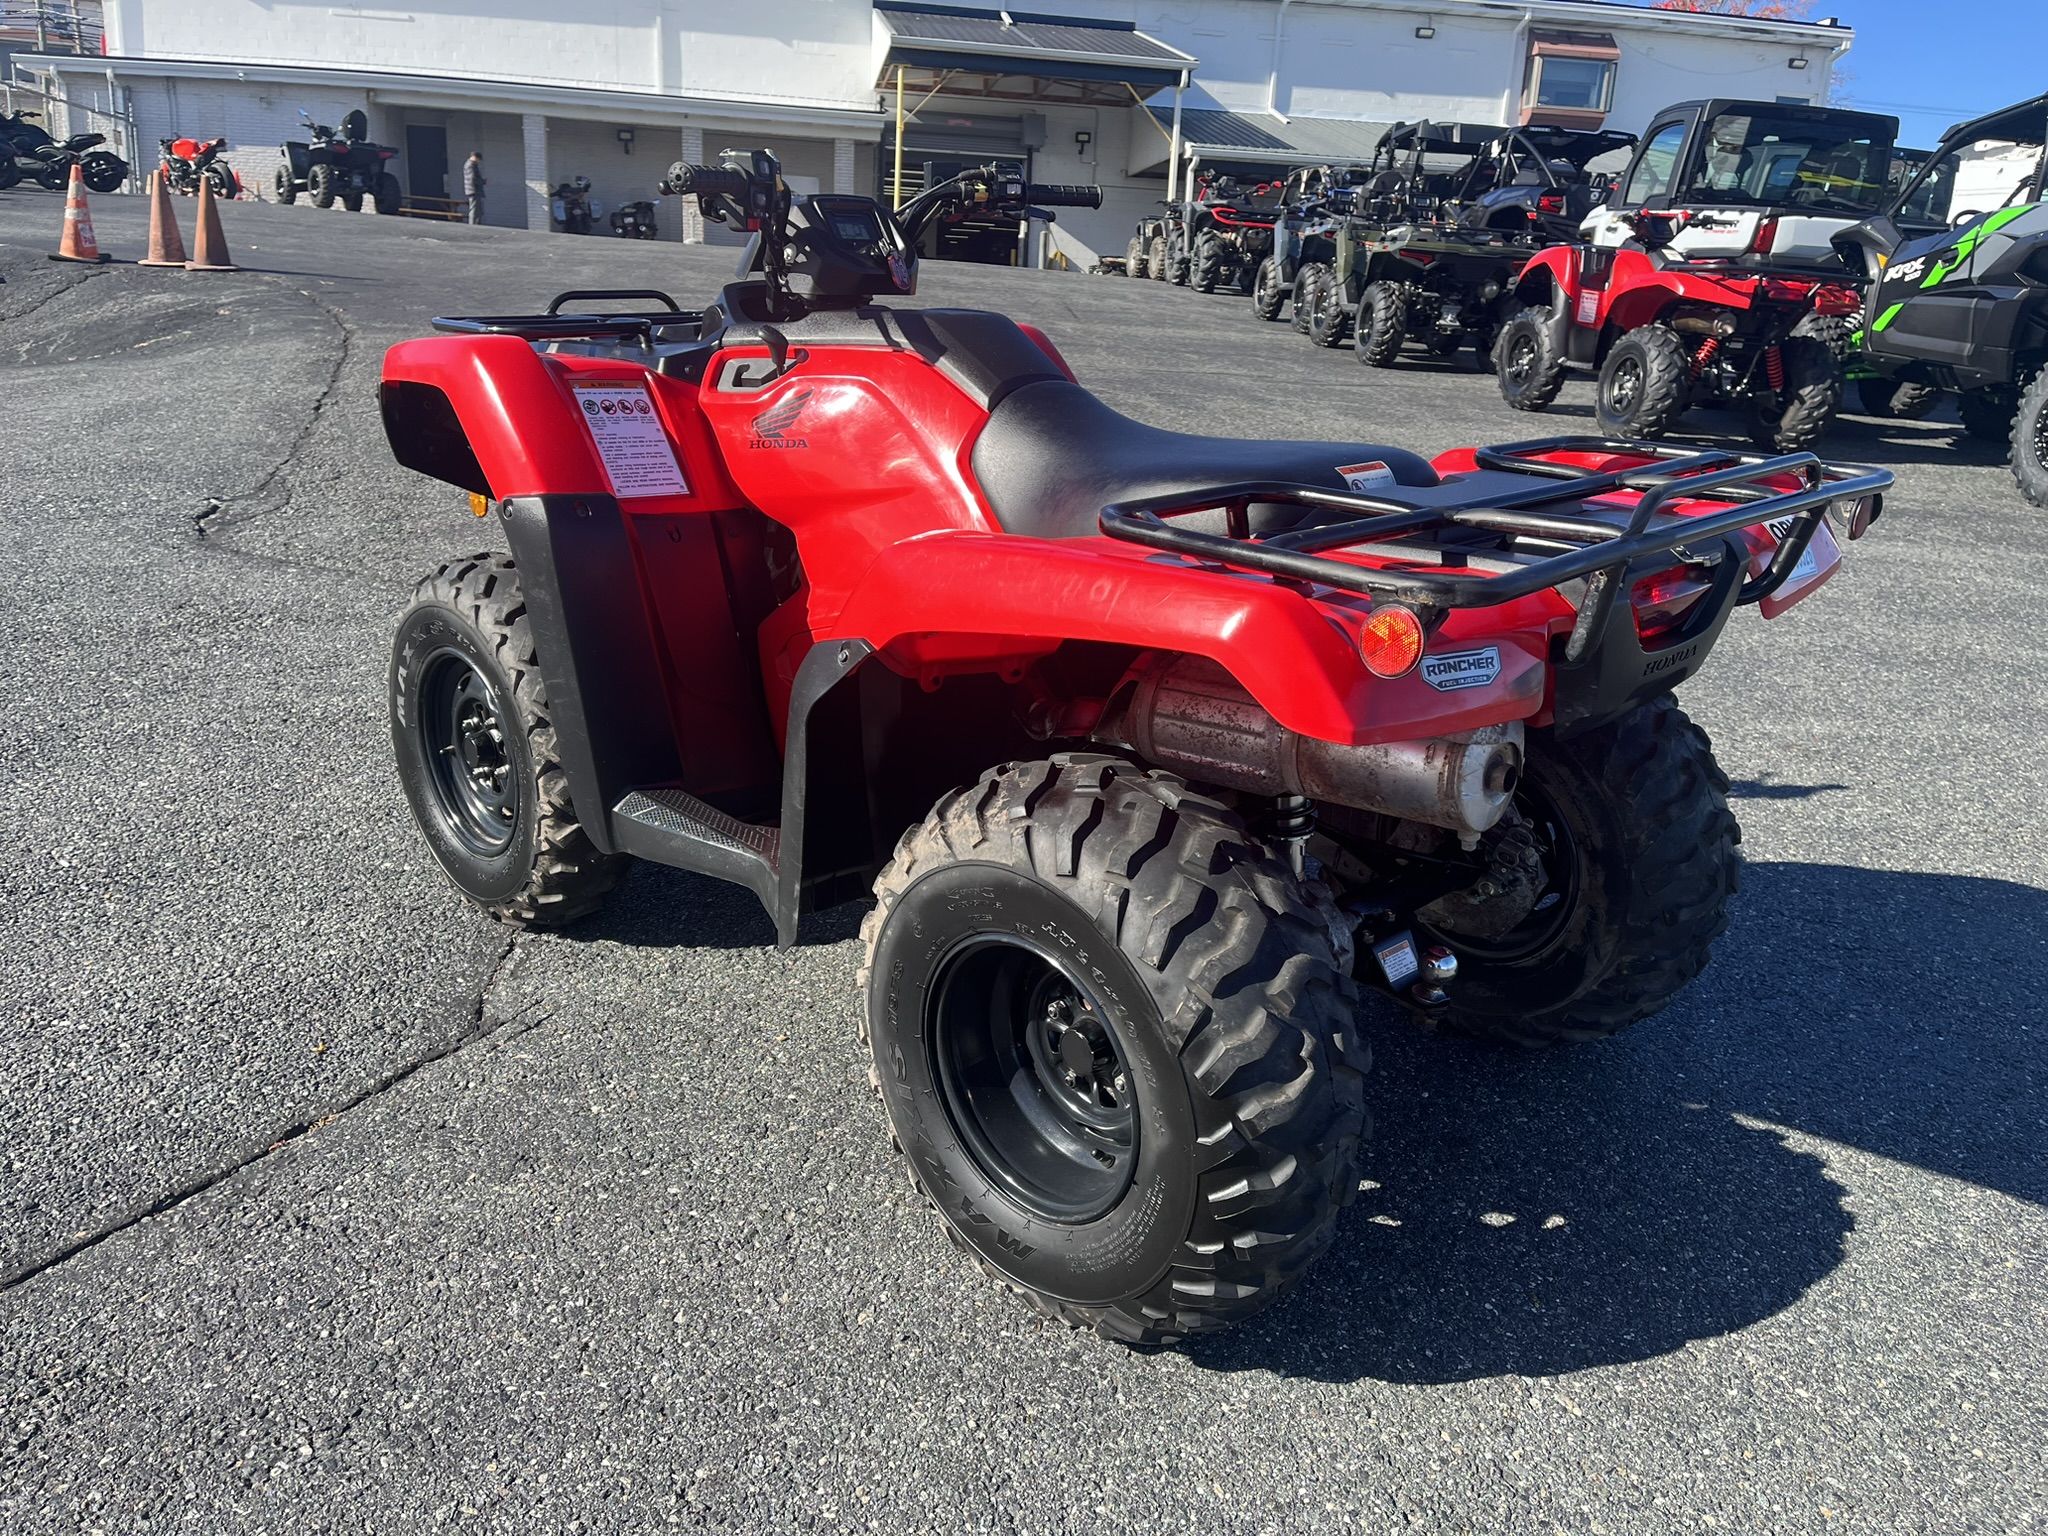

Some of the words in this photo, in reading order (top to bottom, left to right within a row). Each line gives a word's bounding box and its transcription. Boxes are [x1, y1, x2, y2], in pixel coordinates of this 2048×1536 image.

[1883, 256, 1926, 283] KRX
[749, 438, 809, 450] HONDA
[396, 619, 445, 729] MAXXIS
[1425, 656, 1496, 678] RANCHER
[1643, 644, 1698, 677] HONDA
[1442, 680, 1458, 688] FUEL
[1458, 675, 1488, 686] INJECTION
[887, 1040, 1038, 1262] MAXXIS
